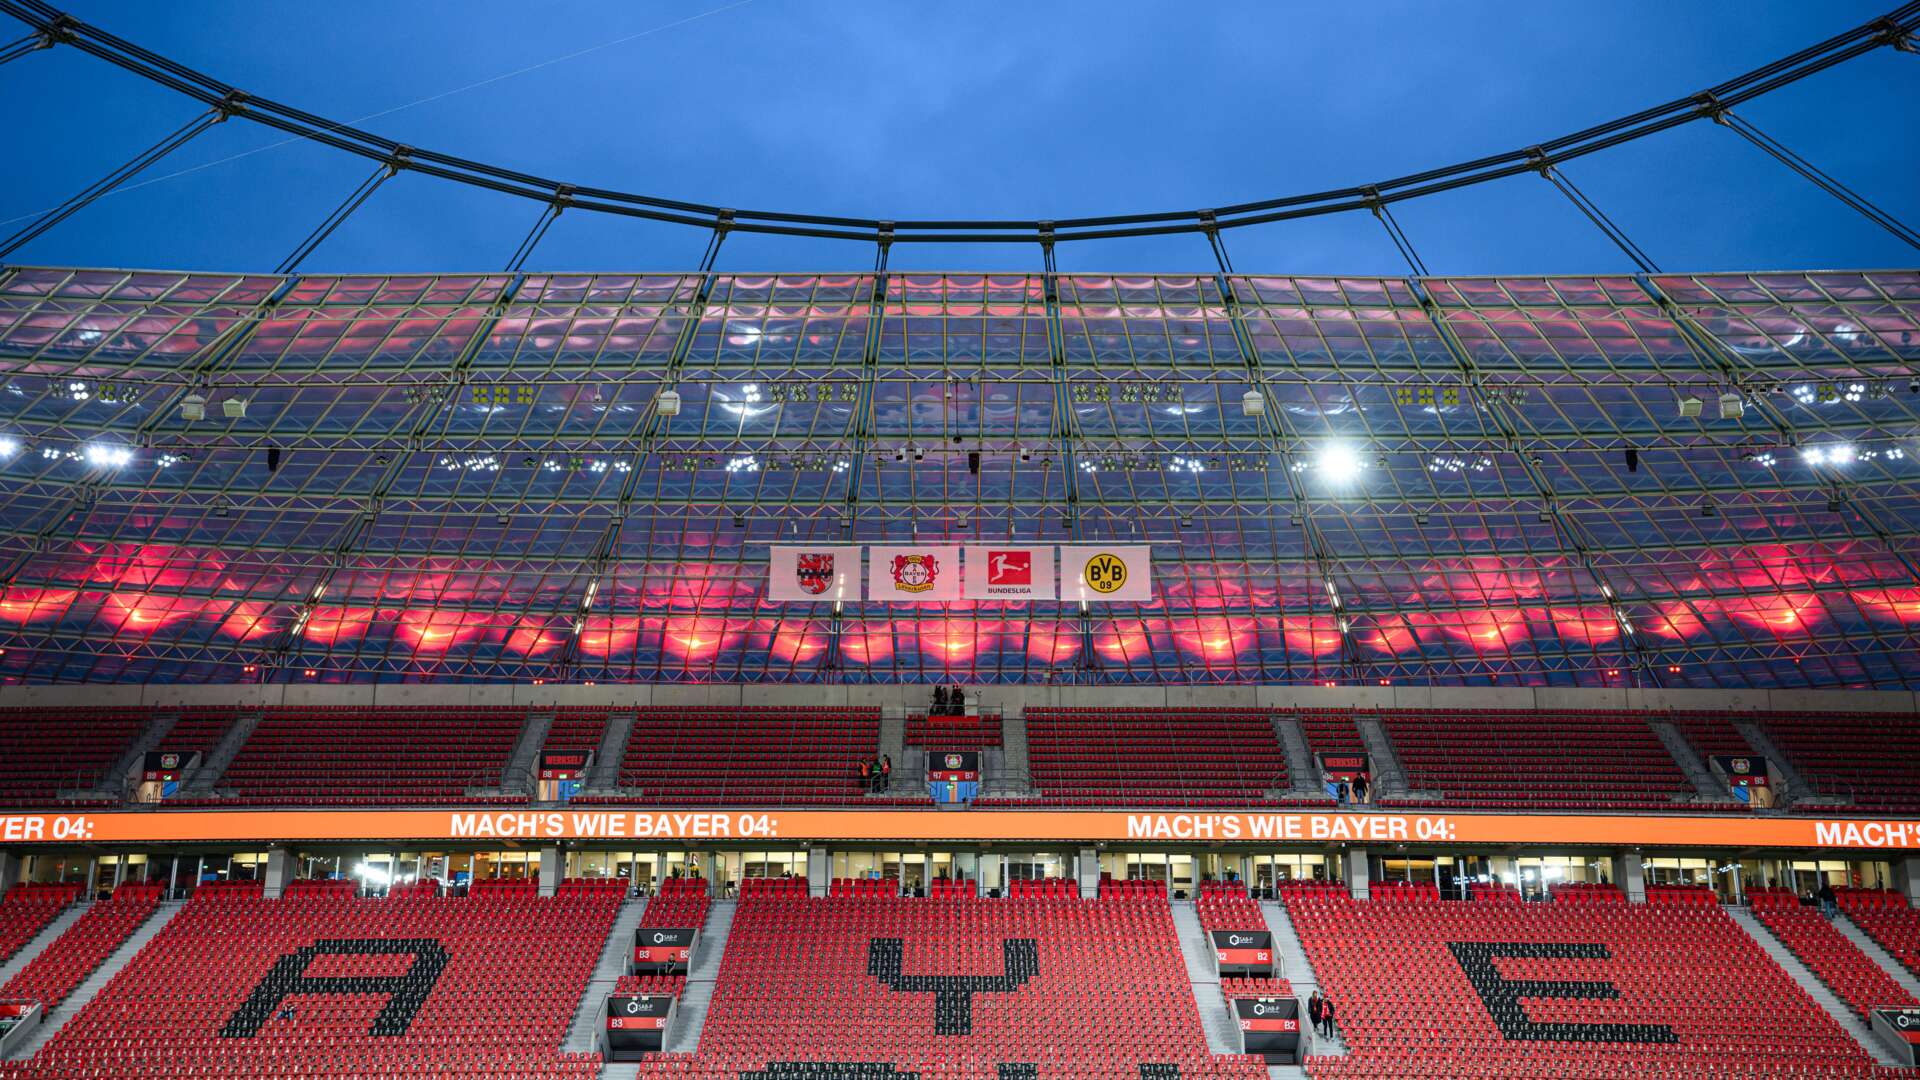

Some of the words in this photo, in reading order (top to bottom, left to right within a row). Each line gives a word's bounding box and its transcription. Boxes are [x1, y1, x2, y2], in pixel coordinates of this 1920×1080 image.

[1091, 557, 1123, 581] BVB
[1100, 580, 1112, 589] 09
[53, 816, 94, 839] 04:
[450, 813, 564, 836] MACH'S
[573, 814, 626, 836] WIE
[634, 814, 730, 836] BAYER
[738, 815, 777, 837] 04:
[1127, 815, 1241, 838] MACH'S
[1247, 816, 1303, 838] WIE
[1311, 816, 1408, 839] BAYER
[1415, 817, 1456, 840] 04:
[1815, 822, 1920, 846] MACH'
[639, 950, 650, 959] B3
[1257, 952, 1268, 961] B2
[611, 1018, 623, 1028] B3
[1284, 1020, 1297, 1030] B2
